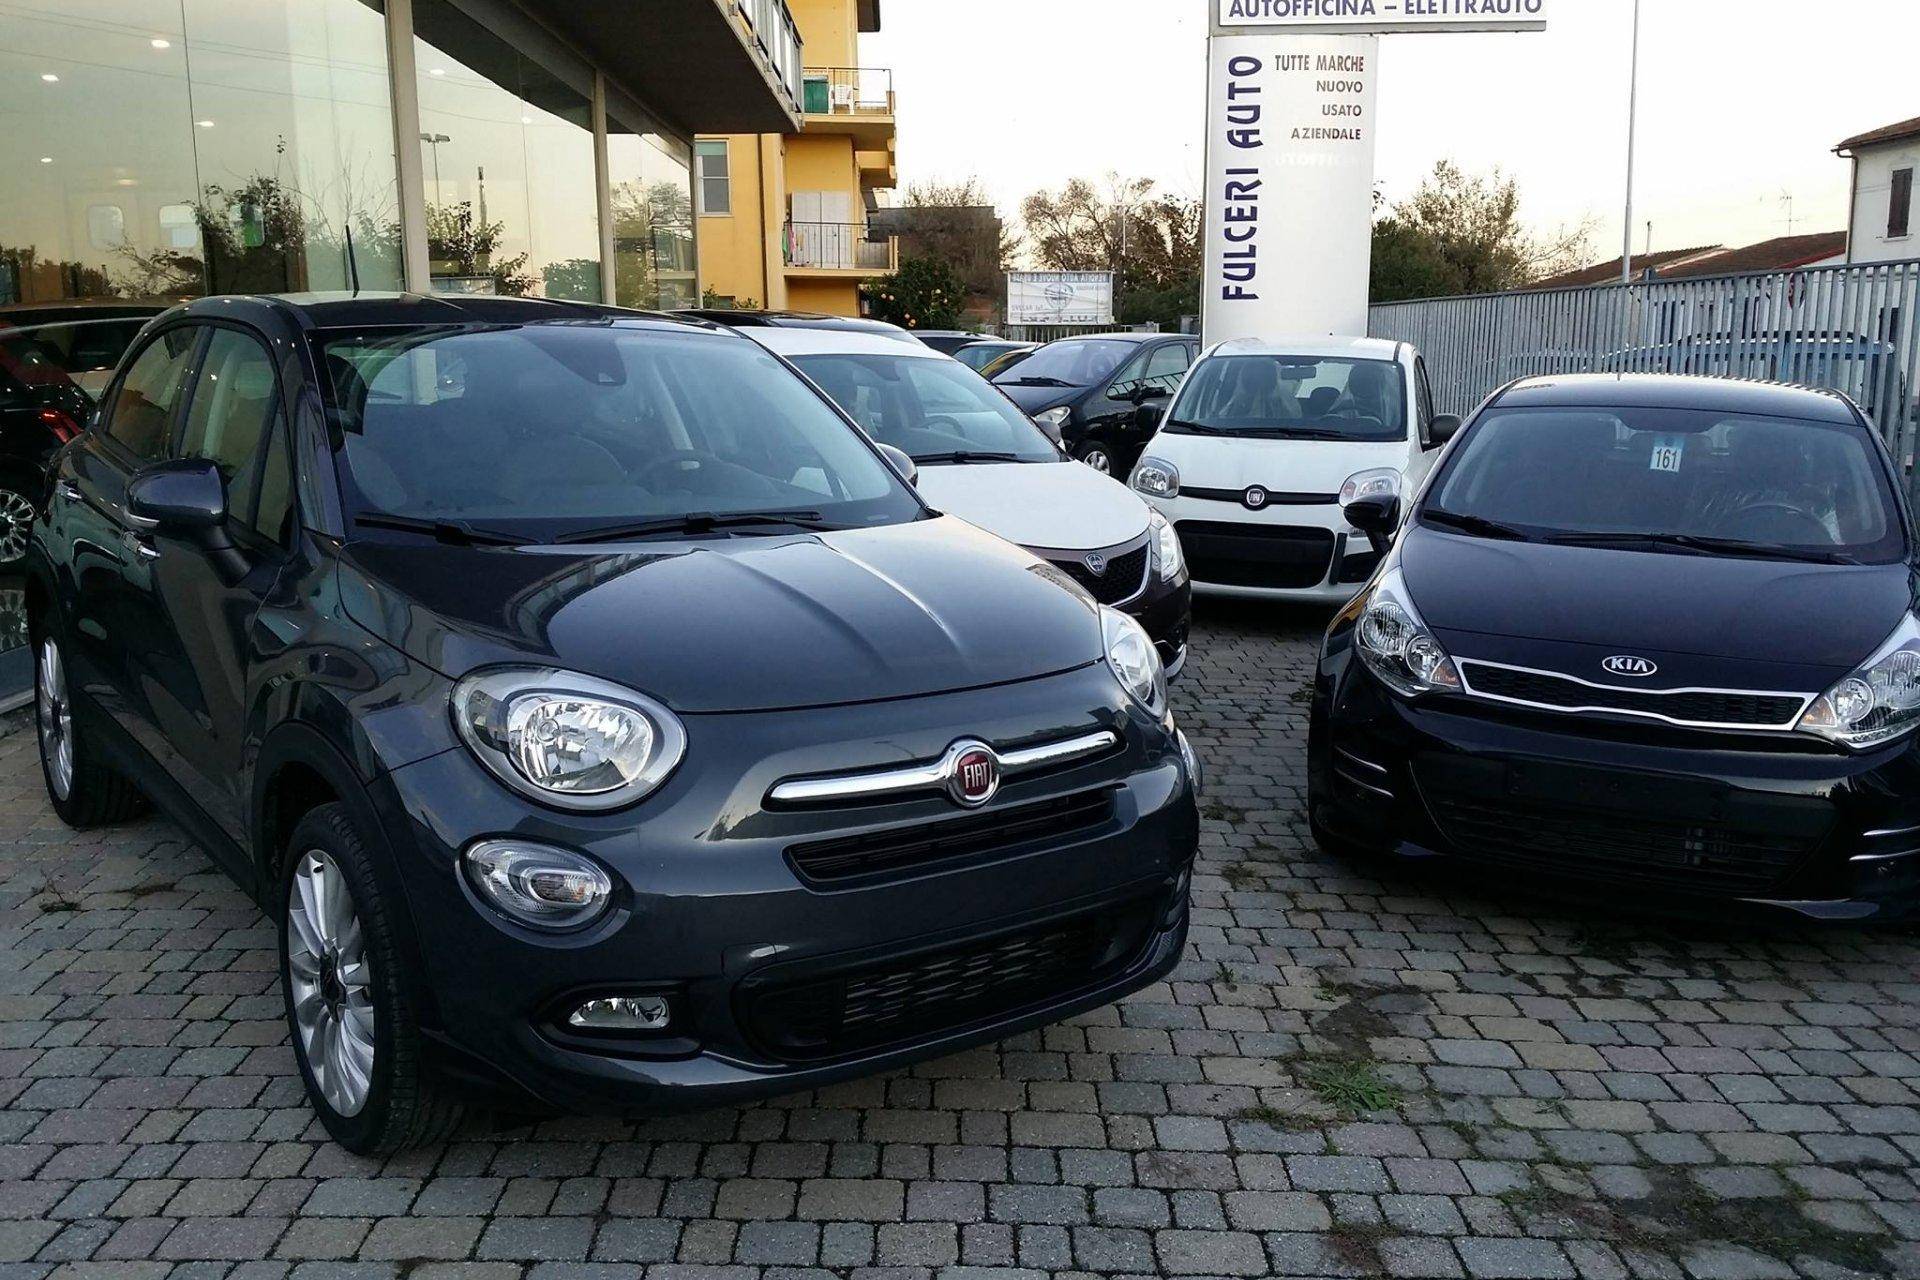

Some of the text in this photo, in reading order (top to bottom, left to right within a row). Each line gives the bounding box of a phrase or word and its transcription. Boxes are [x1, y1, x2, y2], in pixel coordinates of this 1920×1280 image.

[1229, 0, 1376, 17] AUTOFFICINA
[1405, 0, 1542, 15] ELETTRAUTO
[1275, 54, 1364, 72] TUTTE MARCHE
[1316, 80, 1363, 93] NUOVO
[1322, 104, 1362, 117] USATO
[1291, 127, 1361, 140] AZIENDALE
[1222, 55, 1263, 300] FULCERI AUTO
[1656, 448, 1678, 470] 161
[1611, 658, 1648, 672] KIA
[963, 761, 988, 789] FIAT
